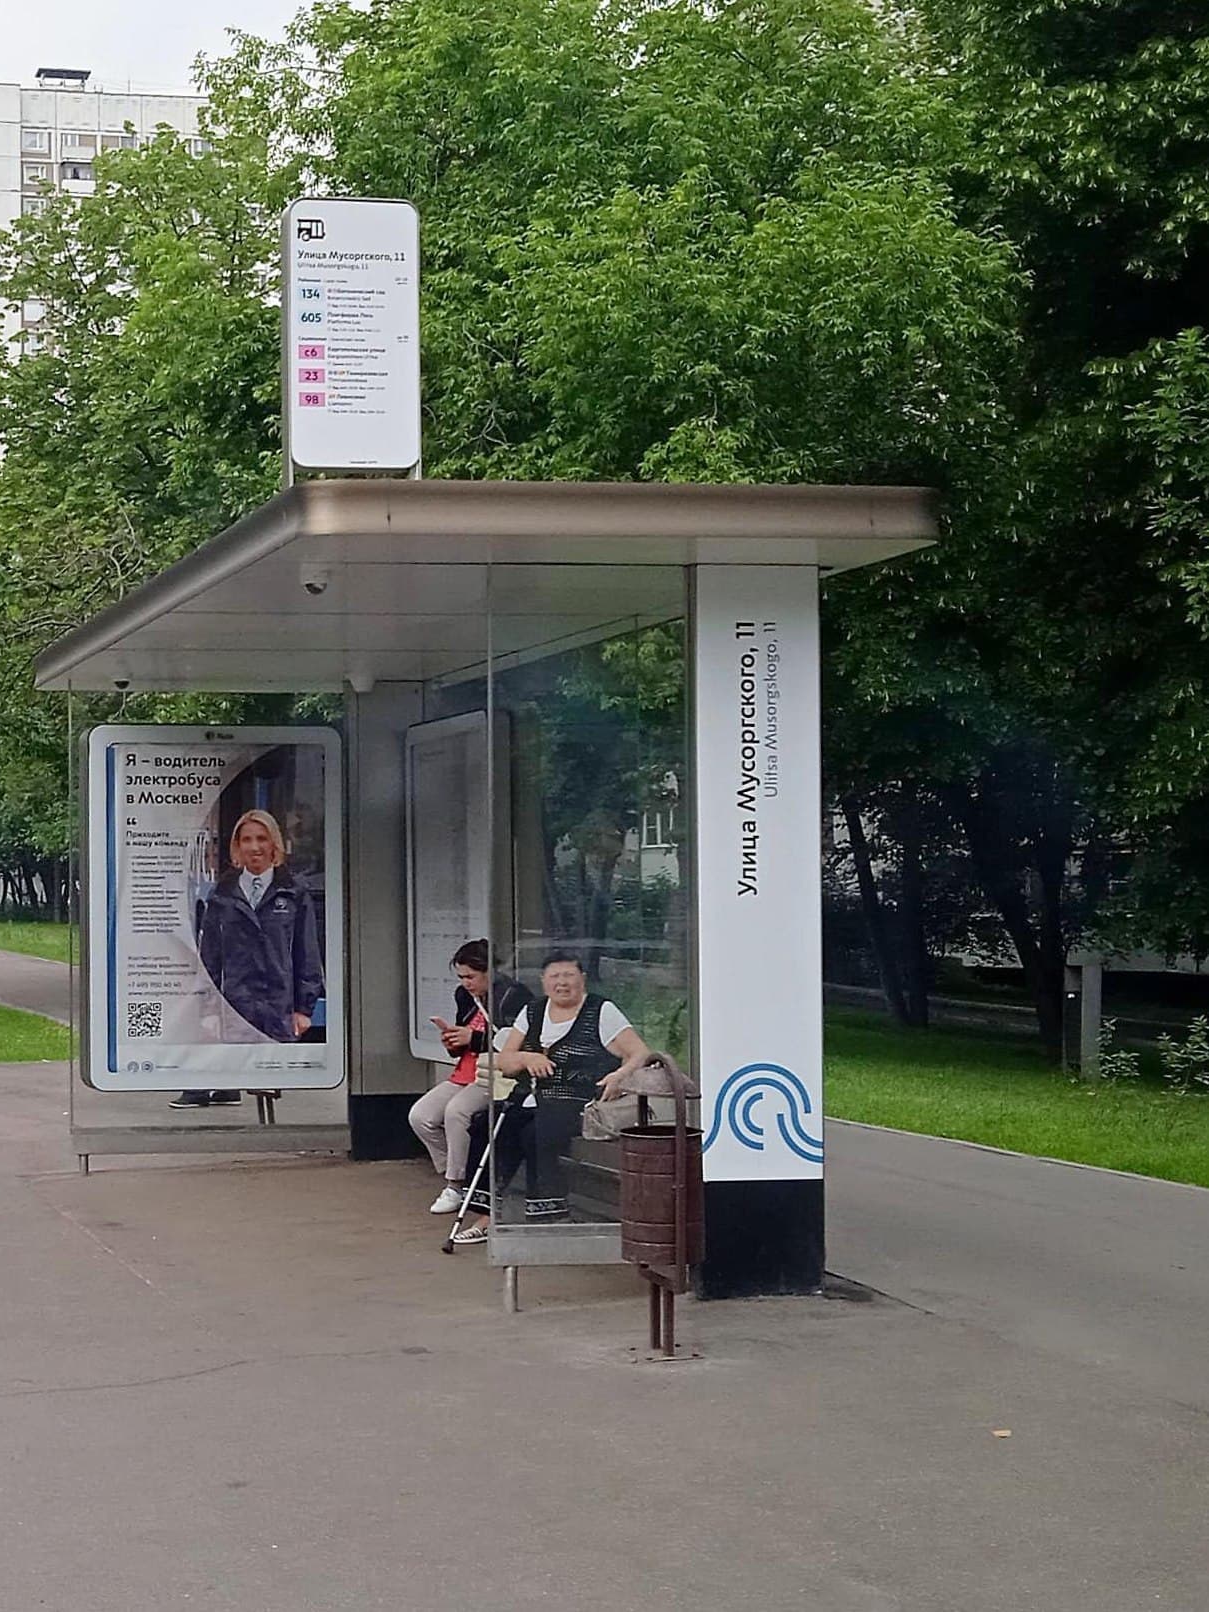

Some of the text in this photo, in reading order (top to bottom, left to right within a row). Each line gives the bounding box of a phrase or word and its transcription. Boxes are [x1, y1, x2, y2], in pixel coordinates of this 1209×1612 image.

[297, 250, 405, 262] Улица Мусоргского, 11
[302, 289, 320, 299] 134
[301, 312, 322, 323] 605
[305, 371, 318, 381] 23
[305, 395, 319, 405] 98
[763, 622, 780, 798] Ulitsa Musorgskogo, 11
[126, 754, 136, 766] Я
[154, 757, 226, 769] водитель
[736, 622, 760, 896] Улица Мусоргского, 11
[126, 772, 221, 788] электробуса
[126, 791, 203, 804] в Москве!
